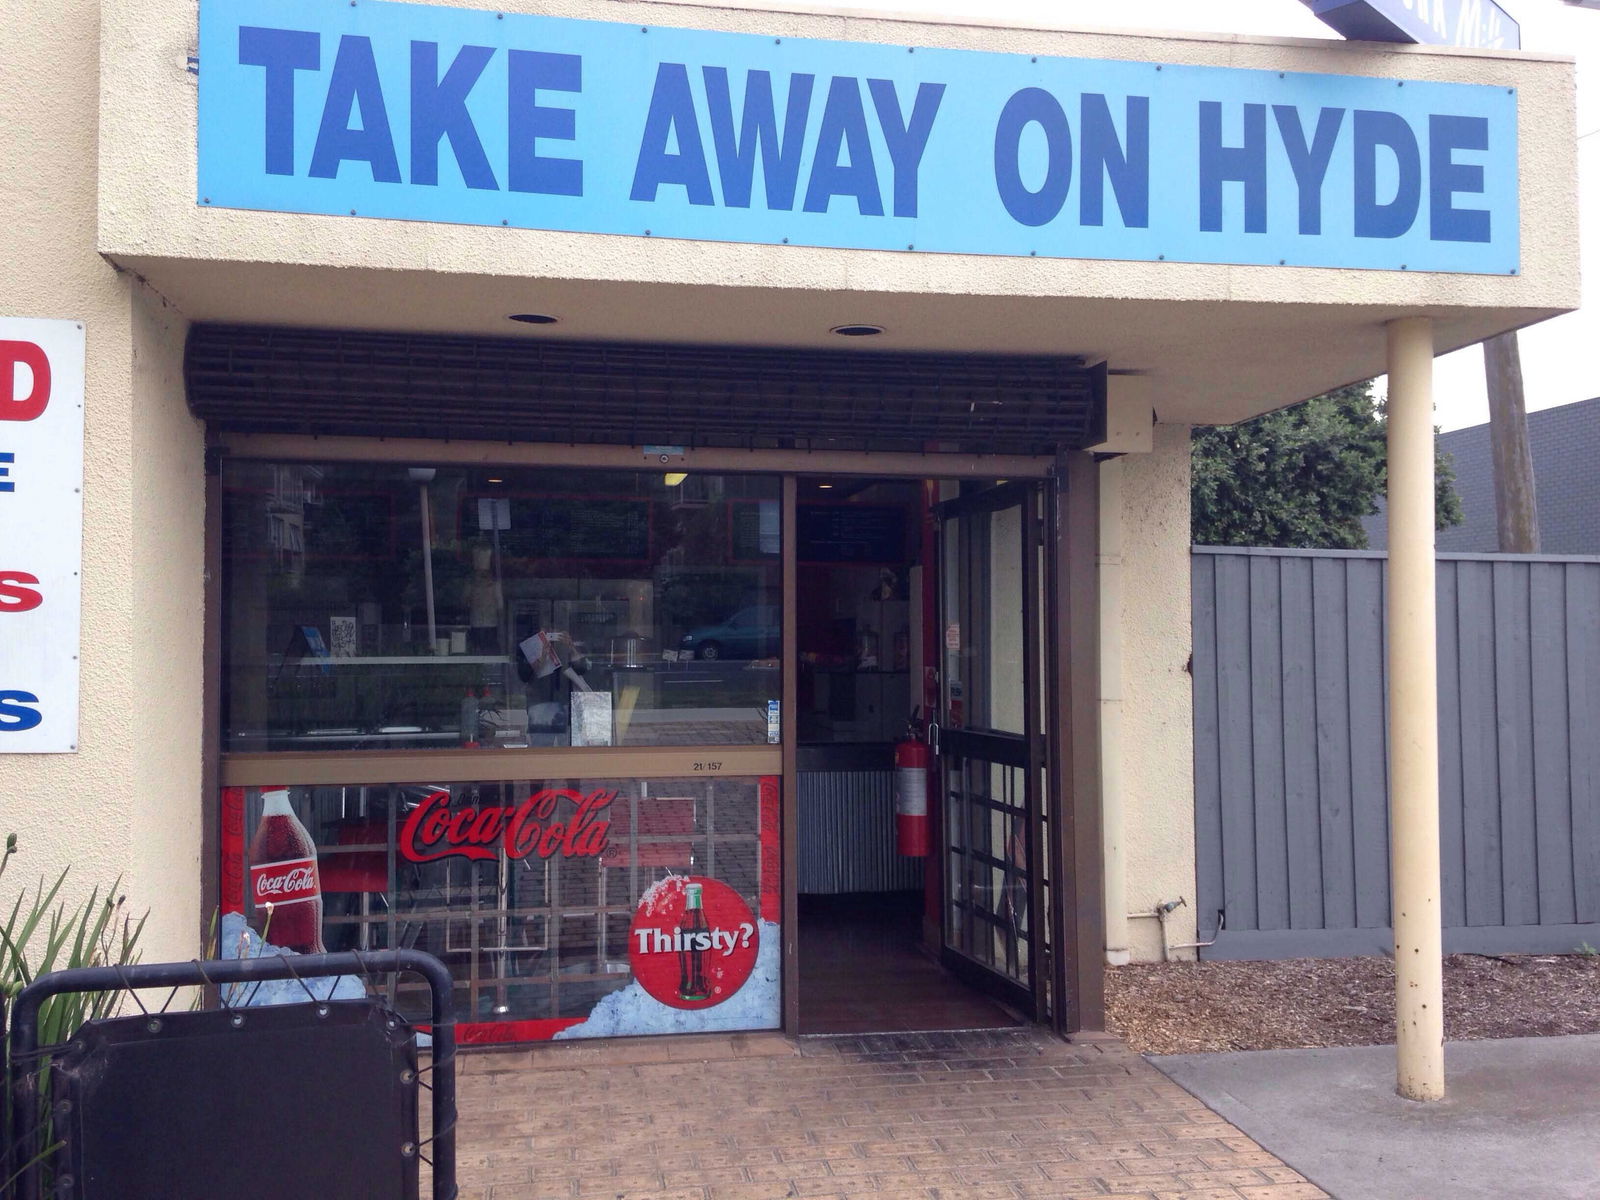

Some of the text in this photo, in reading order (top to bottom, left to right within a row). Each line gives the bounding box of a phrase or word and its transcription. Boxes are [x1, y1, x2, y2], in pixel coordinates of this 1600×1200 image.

[239, 26, 1491, 243] TAKE AWAY ON HYDE
[401, 788, 618, 863] Coca-Cola
[256, 866, 316, 897] Coca-Cola
[634, 922, 754, 957] Thirsty?
